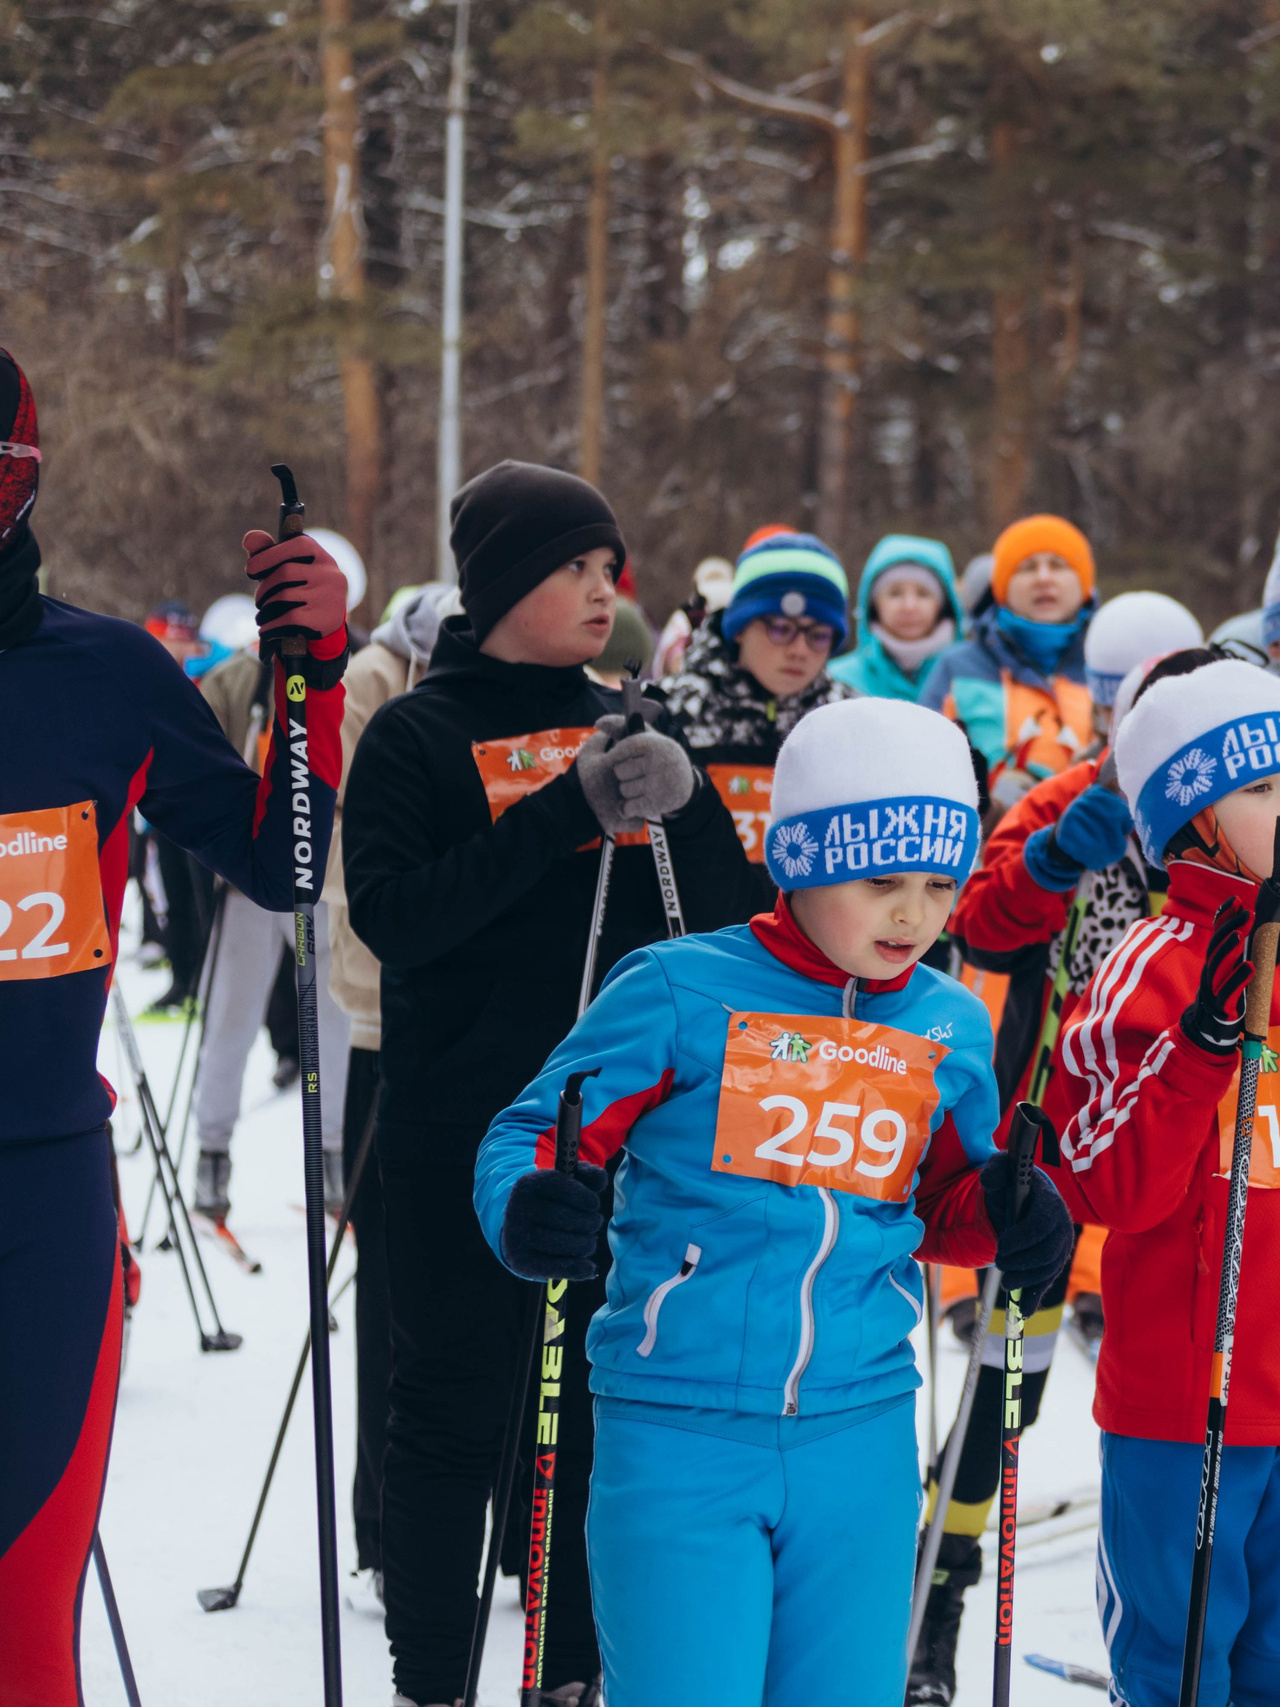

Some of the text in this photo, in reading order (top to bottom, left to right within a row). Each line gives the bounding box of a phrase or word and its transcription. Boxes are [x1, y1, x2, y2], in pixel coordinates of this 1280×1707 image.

[289, 718, 313, 890] NORDWAY
[824, 804, 967, 846] ЛЫЖНЯ
[652, 831, 677, 912] NORDWAY
[825, 836, 964, 874] РОССИИ
[296, 911, 306, 966] CARBON
[819, 1040, 907, 1075] Goodline
[307, 1071, 318, 1094] RS
[754, 1094, 907, 1179] 259
